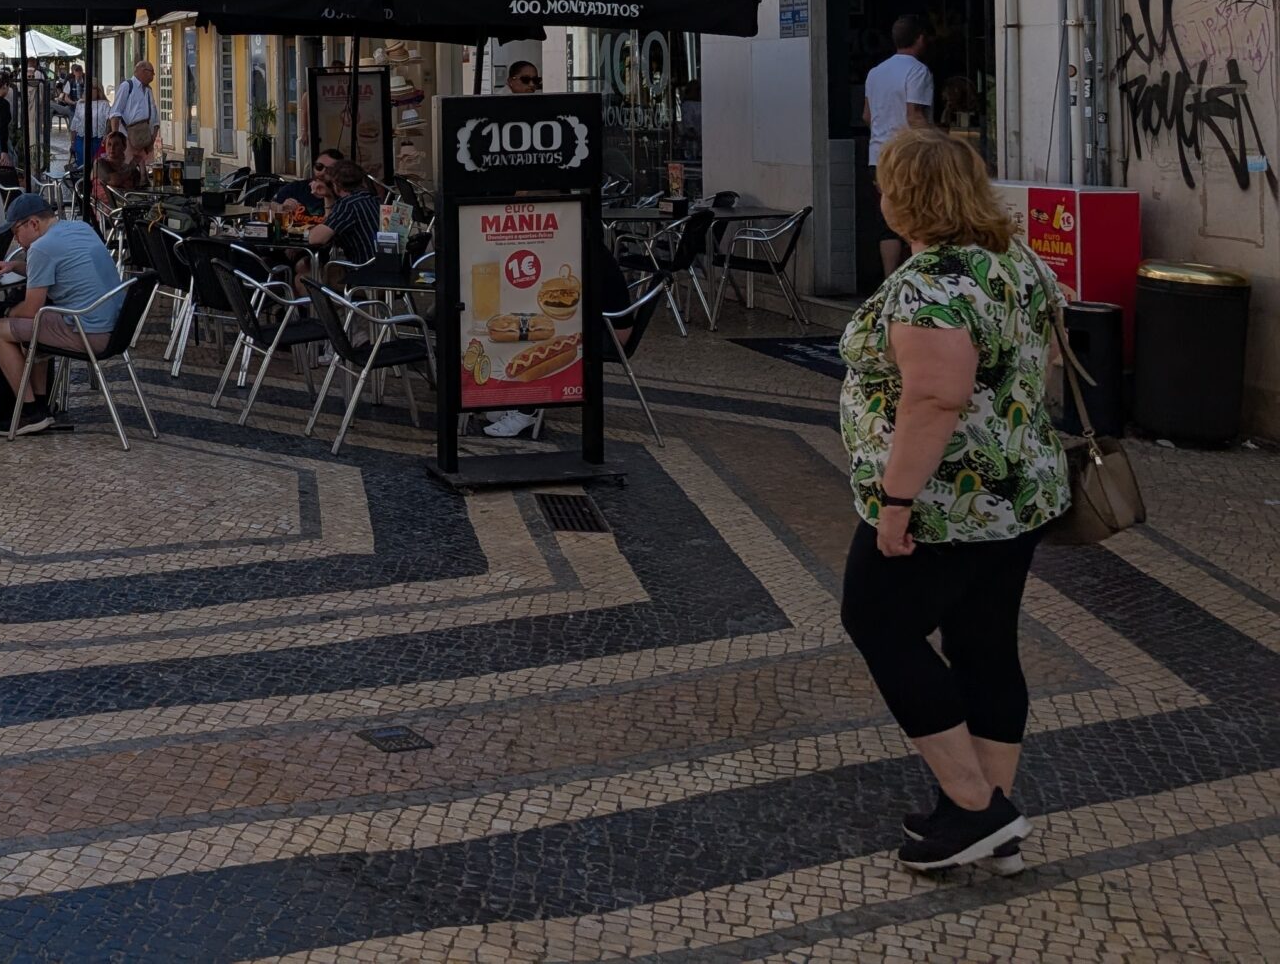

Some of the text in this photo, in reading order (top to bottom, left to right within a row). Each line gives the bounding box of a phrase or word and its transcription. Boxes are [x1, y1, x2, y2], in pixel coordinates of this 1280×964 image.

[508, 0, 541, 14] 100
[481, 120, 563, 153] 100
[481, 152, 564, 167] MONTADITOS
[504, 202, 536, 214] euro
[481, 212, 559, 233] MANIA
[1031, 238, 1074, 256] MANIA
[508, 255, 537, 279] 1€
[562, 386, 582, 396] 100
